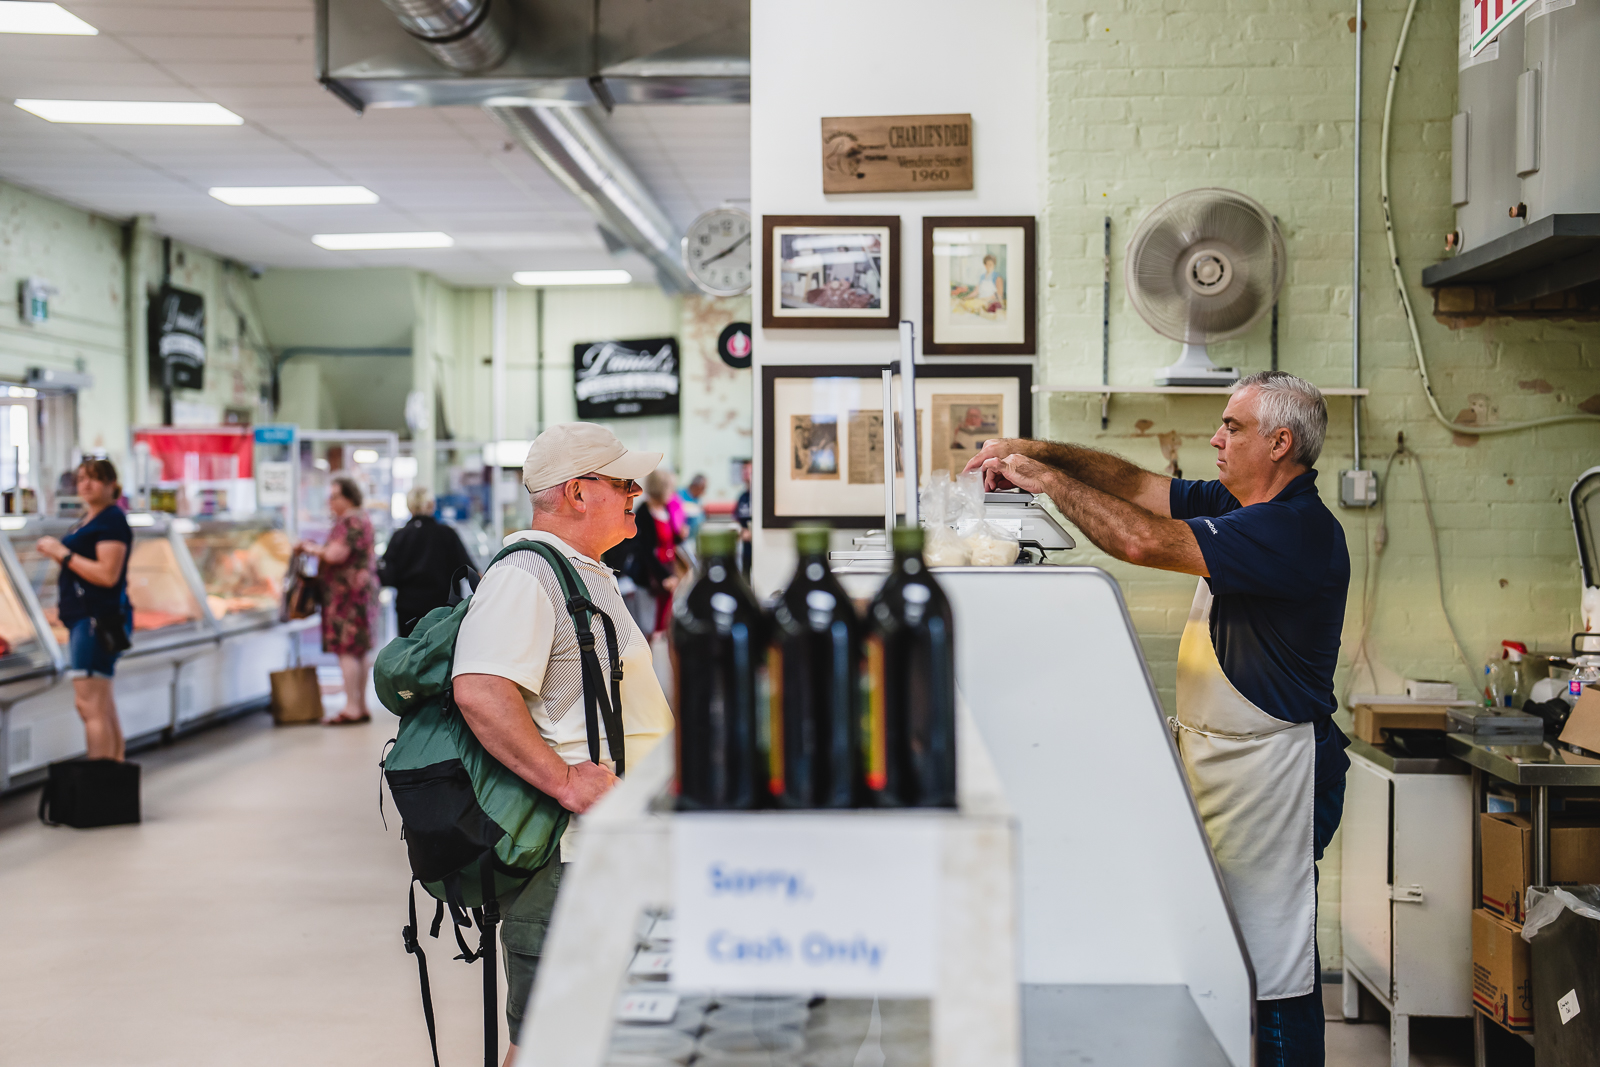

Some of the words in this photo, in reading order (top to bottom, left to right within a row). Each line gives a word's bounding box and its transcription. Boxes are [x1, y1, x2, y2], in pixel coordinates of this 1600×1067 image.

[944, 123, 969, 147] DELI
[911, 169, 950, 182] 1960
[707, 931, 791, 964] Cash
[801, 933, 886, 970] Only
